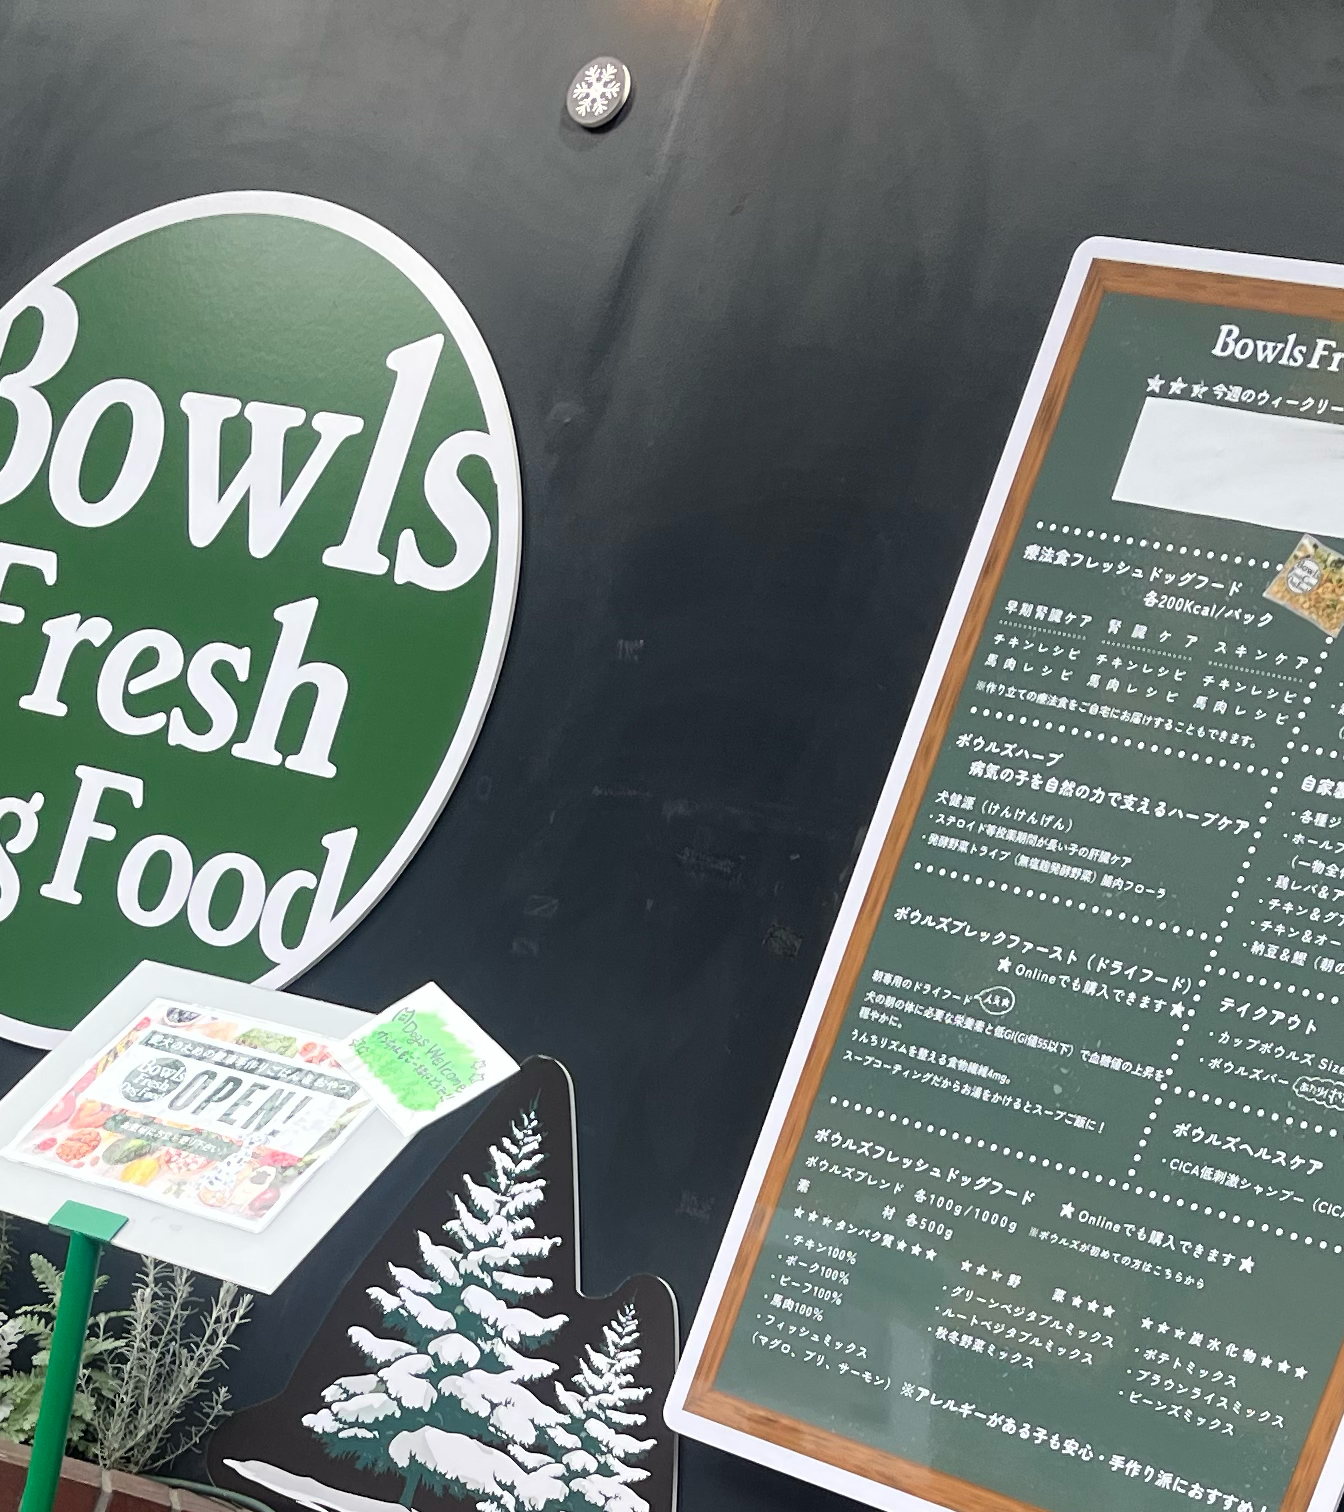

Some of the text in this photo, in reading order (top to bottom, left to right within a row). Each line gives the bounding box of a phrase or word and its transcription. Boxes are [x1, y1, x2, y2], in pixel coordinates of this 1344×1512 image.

[1212, 325, 1306, 367] Bowls
[1023, 544, 1242, 596] 療法食フレッシュドッグフード
[1005, 600, 1092, 627] 早期腎臓ケア
[1215, 642, 1308, 669] スキンケア
[985, 653, 1289, 725] 馬肉レシピ 馬肉レシピ 馬肉レシピ
[994, 634, 1297, 703] チキンレシピ チキンレシピ チキンレシピ
[40, 765, 359, 965] Food
[1220, 998, 1316, 1034] テイクアウト
[402, 1022, 467, 1093] Dogs Welcome
[815, 1129, 1035, 1205] ボウルズフレッシュドッグフード
[1173, 1123, 1323, 1174] ボウルズヘルスケア
[794, 1235, 857, 1264] チキン100%
[906, 1213, 953, 1240] 各500g
[770, 1294, 823, 1321] 馬肉100%
[835, 1220, 894, 1248] タンパク質
[1188, 1332, 1256, 1363] 炭水化物
[765, 1315, 866, 1358] フィッシュミックス
